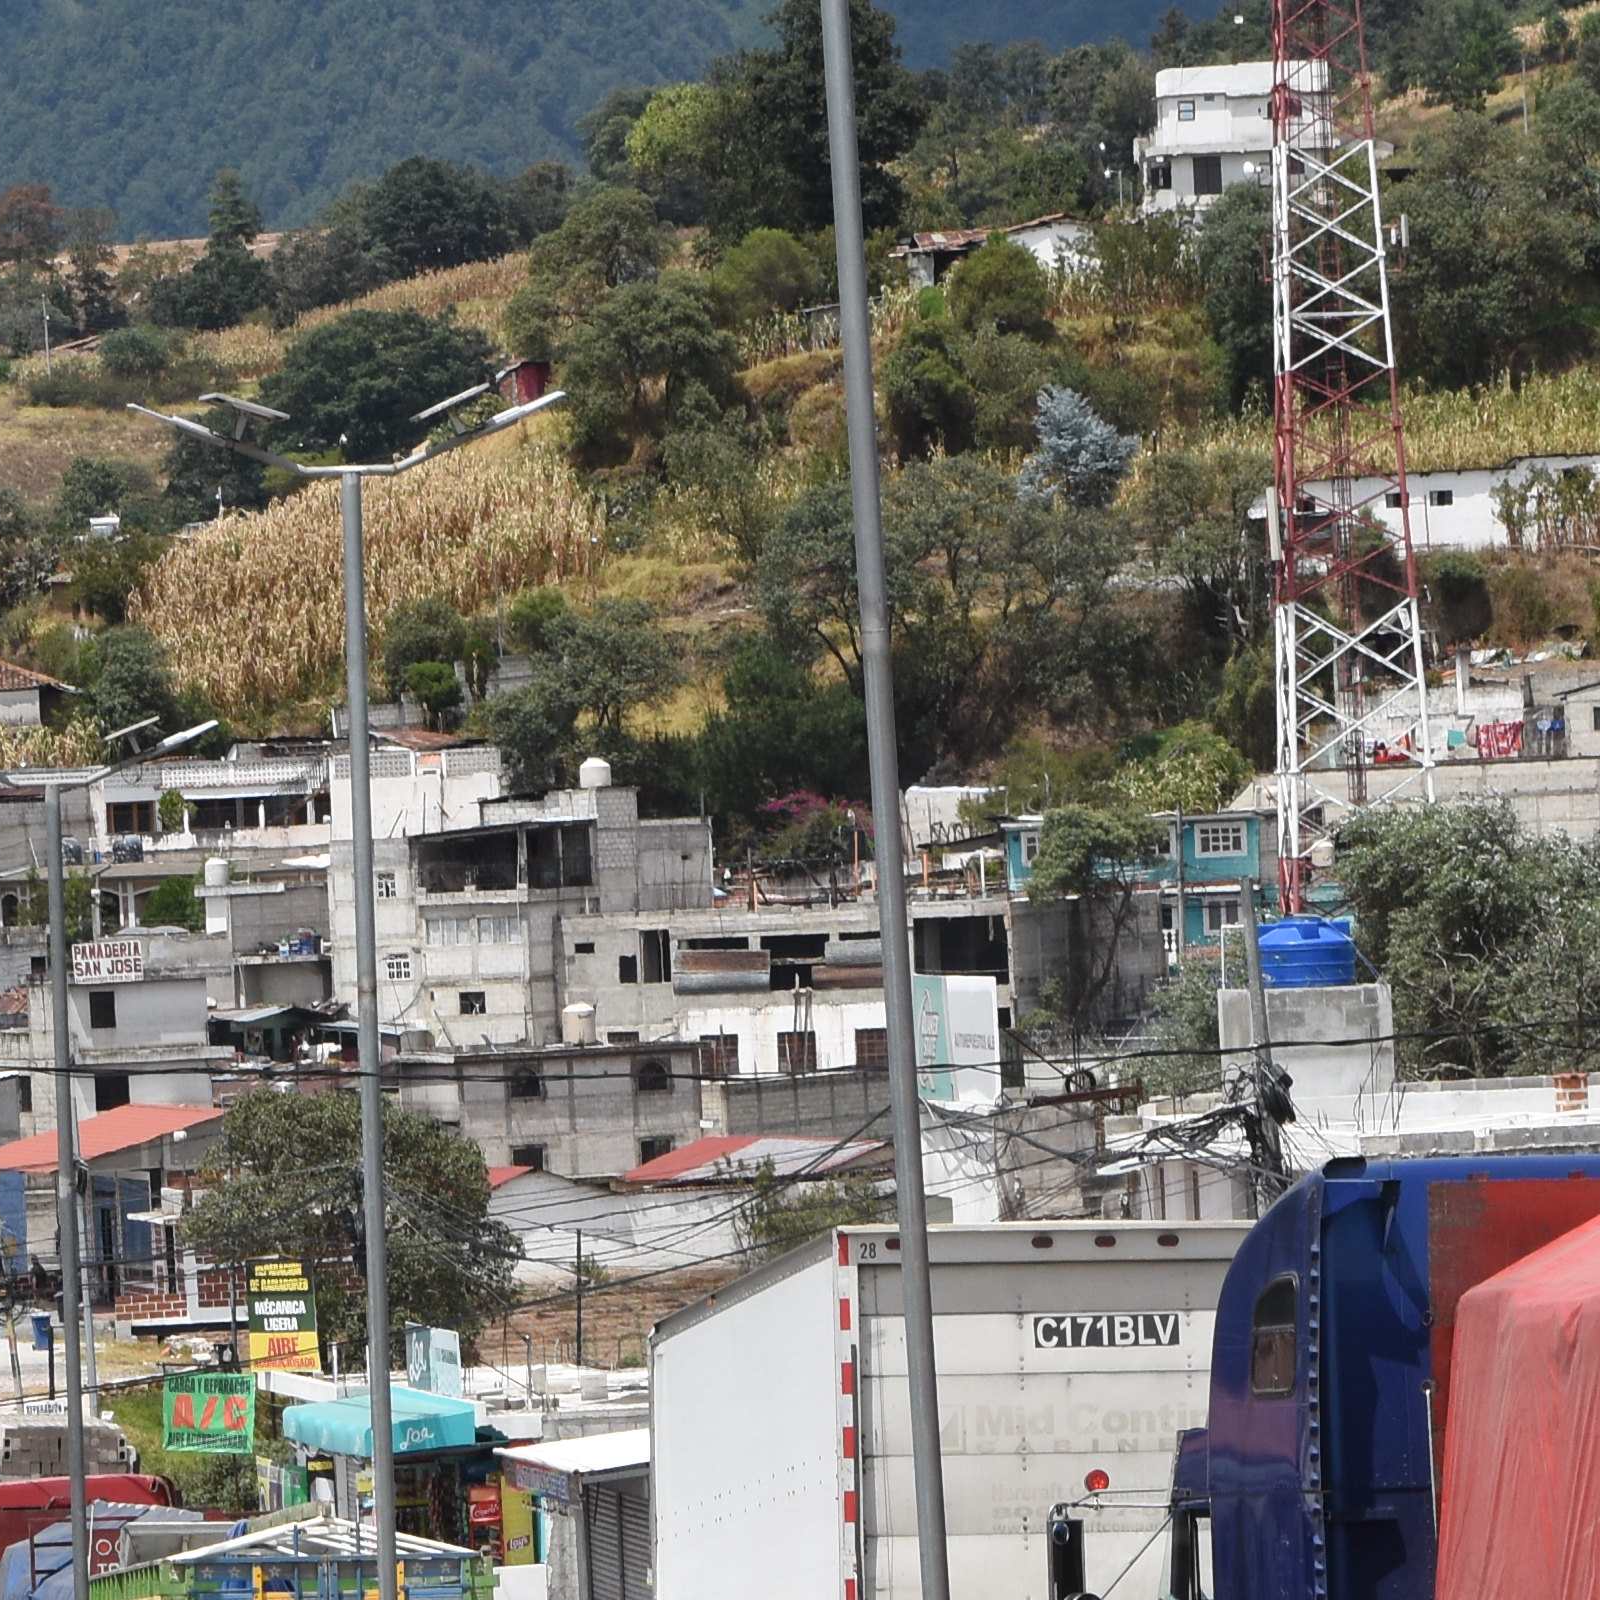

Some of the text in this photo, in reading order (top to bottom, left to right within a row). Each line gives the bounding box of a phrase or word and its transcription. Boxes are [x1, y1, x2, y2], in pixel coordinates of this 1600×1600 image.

[73, 942, 141, 961] PANADERIA
[74, 957, 141, 976] SAN JOSE
[859, 1242, 877, 1260] 28
[263, 1317, 299, 1331] LIGERA
[1036, 1315, 1176, 1349] C171BLV
[266, 1336, 300, 1357] AIRE
[173, 1394, 247, 1430] A/C
